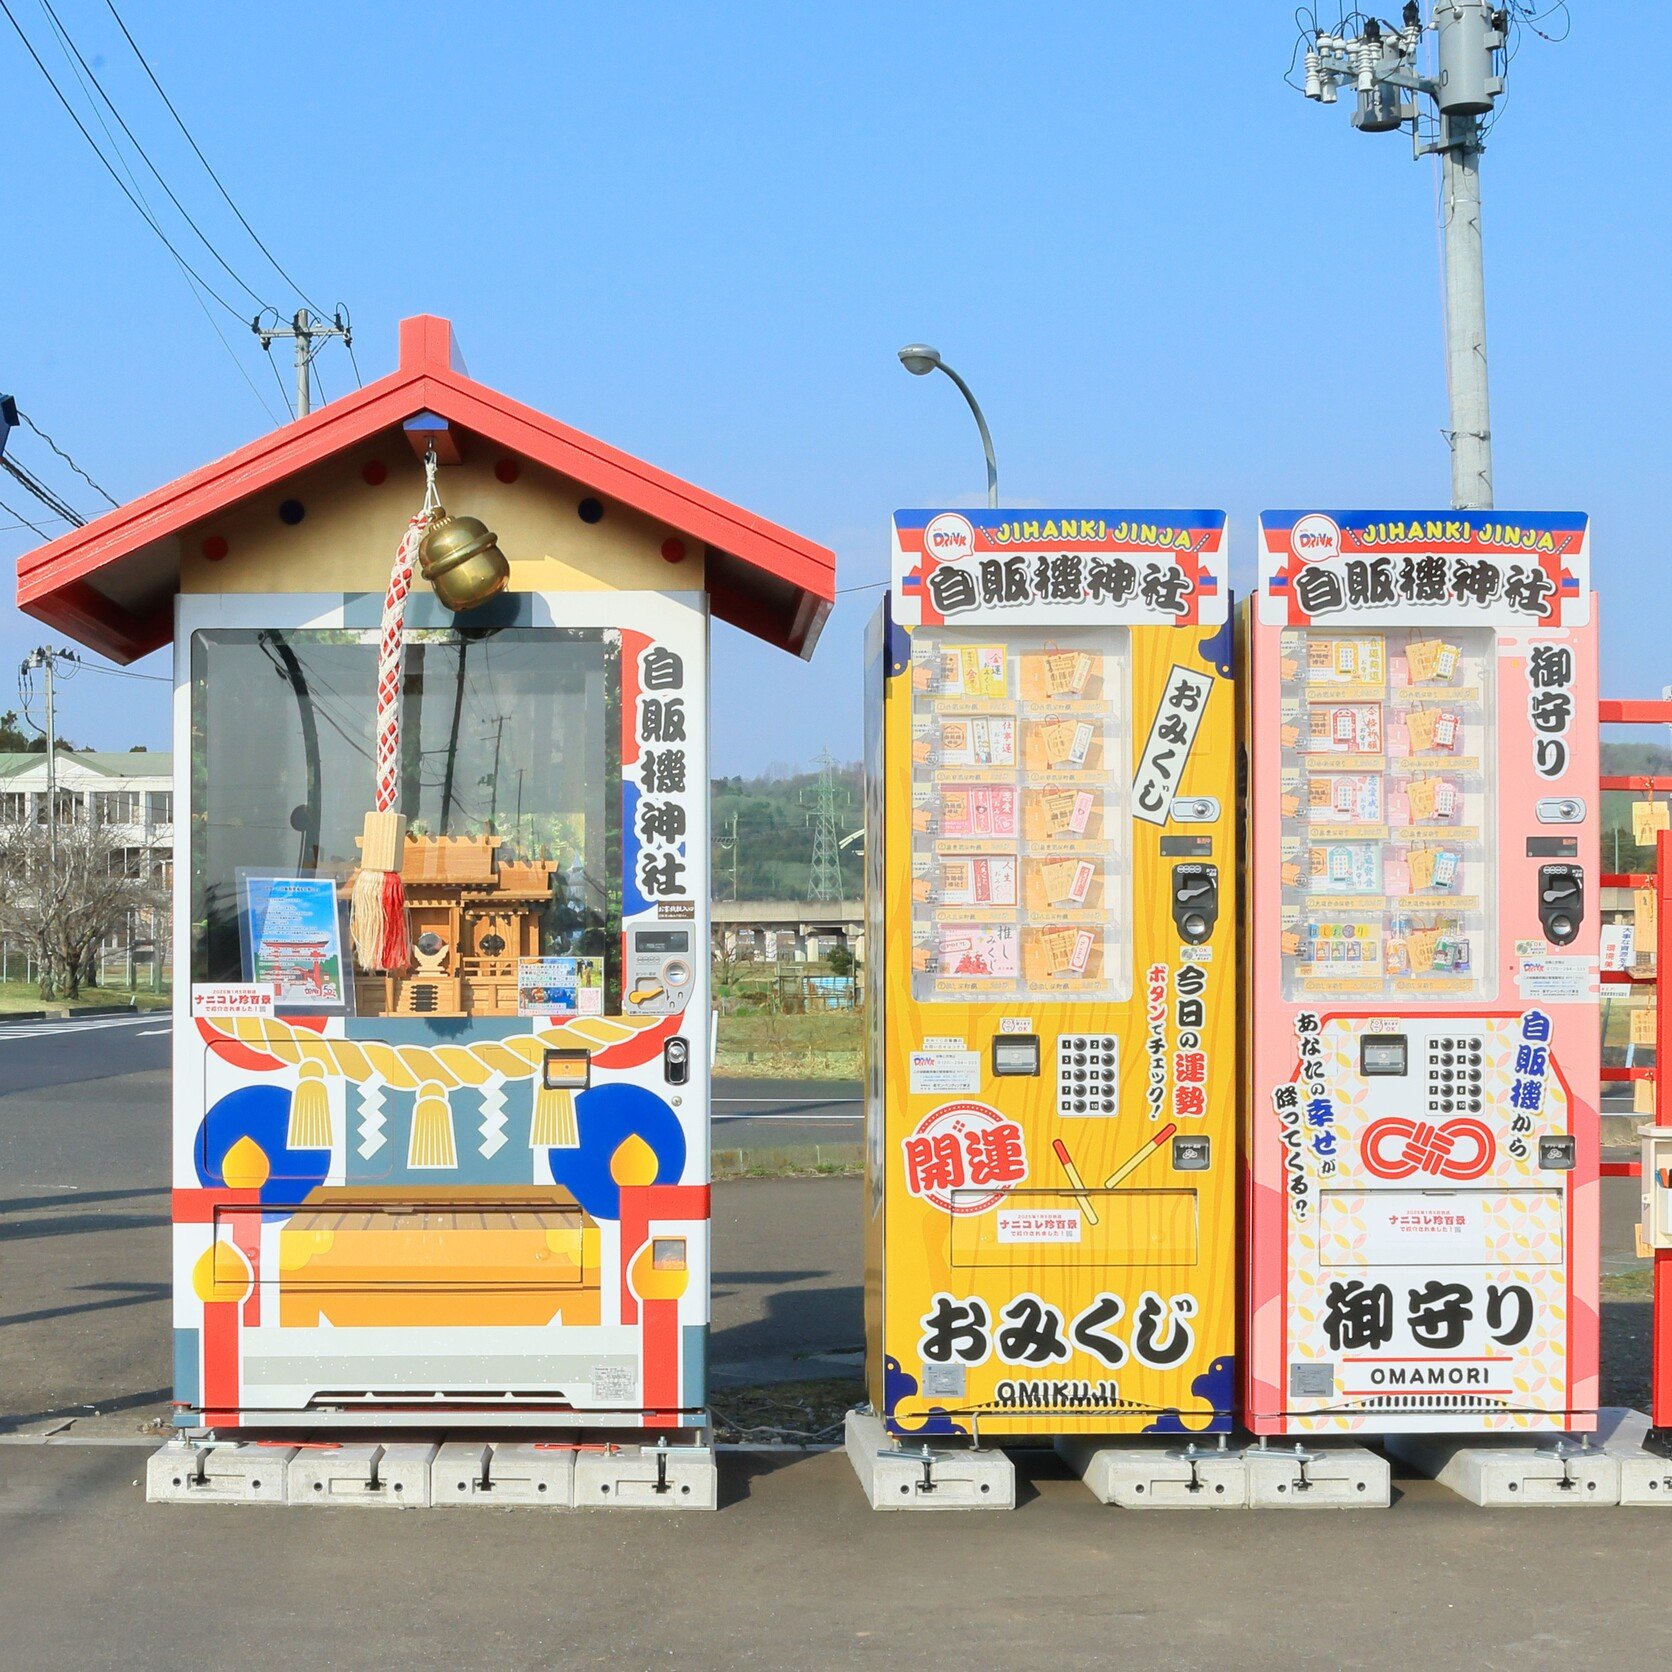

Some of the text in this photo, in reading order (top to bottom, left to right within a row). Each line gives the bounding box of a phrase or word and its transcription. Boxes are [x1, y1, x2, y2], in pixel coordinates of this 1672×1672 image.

[998, 520, 1192, 548] JIHANKI JINJA
[1362, 522, 1555, 549] JIHANKI JINJA
[931, 555, 1190, 612] 自販機神社
[1296, 555, 1553, 613] 自販機神社
[1529, 646, 1571, 777] 御守り
[641, 647, 686, 897] 自販機神社
[1138, 679, 1201, 811] おみくじ
[195, 995, 271, 1005] ナニコレ珍百景
[1149, 966, 1166, 1118] ボタンでチェック！
[1176, 965, 1205, 1115] 今日の運勢
[1509, 1010, 1550, 1158] 自販機から
[905, 1124, 1025, 1193] 開運
[1000, 1219, 1078, 1229] ナニコレ珍百景
[1388, 1215, 1466, 1225] ナニコレ珍百景
[923, 1297, 1192, 1364] おみくじ
[1323, 1280, 1534, 1351] 御守り
[997, 1382, 1117, 1402] OMIKUJI
[1371, 1368, 1489, 1384] OMAMORI
